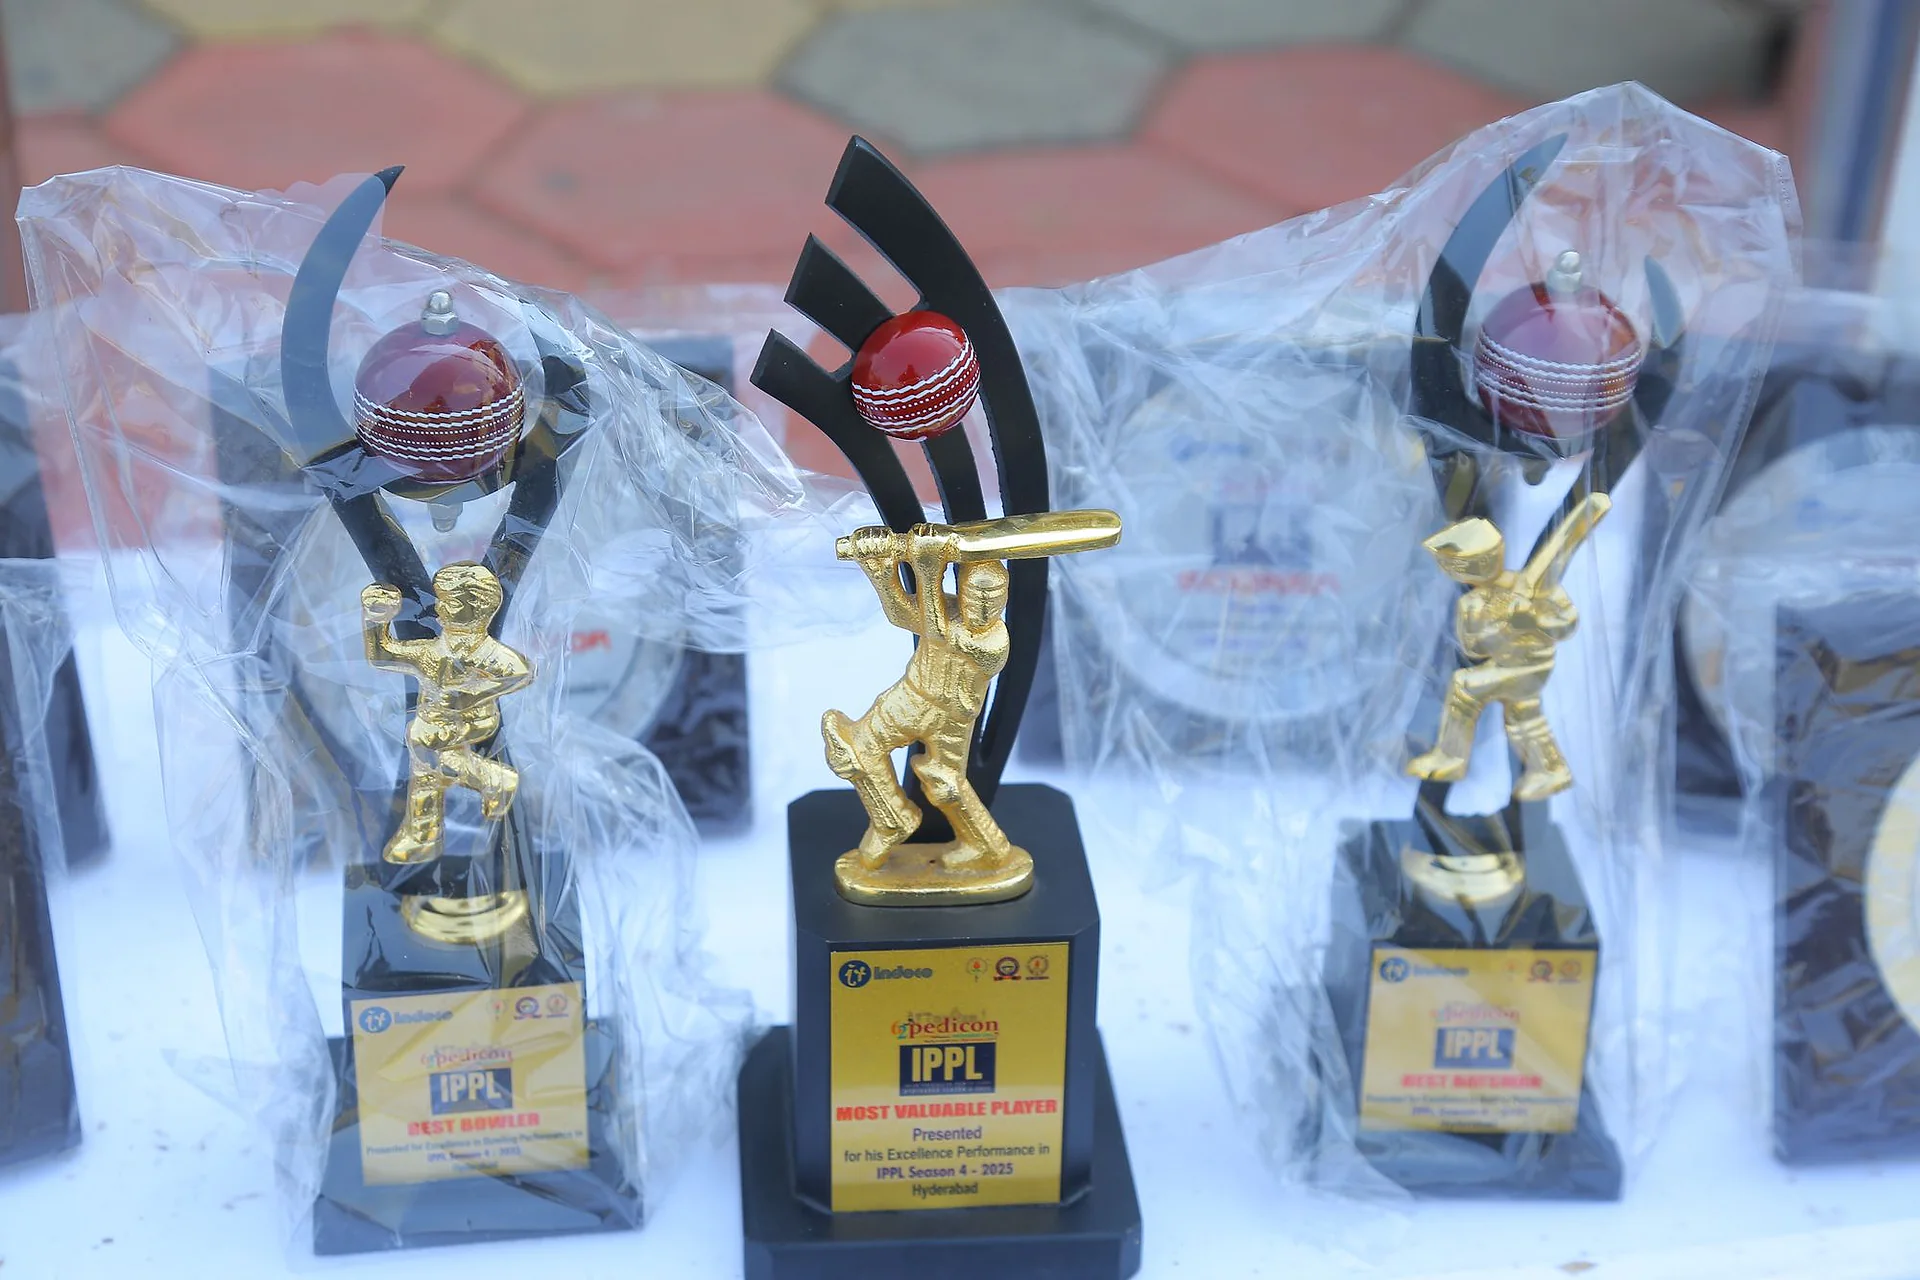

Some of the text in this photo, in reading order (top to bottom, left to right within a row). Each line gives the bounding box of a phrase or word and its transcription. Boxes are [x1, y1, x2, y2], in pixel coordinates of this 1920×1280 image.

[874, 965, 934, 980] Indoco
[1445, 1029, 1504, 1059] IPPL
[912, 1046, 983, 1082] IPPL
[441, 1071, 500, 1102] IPPL
[837, 1099, 1058, 1121] MOST VALUABLE PLAYER
[407, 1112, 540, 1136] BEST BOWLER
[913, 1126, 982, 1141] Presented
[844, 1142, 1050, 1162] for his Excellence Performance in
[877, 1167, 905, 1180] IPPL
[908, 1165, 955, 1179] Season
[959, 1164, 967, 1175] 4
[982, 1162, 1013, 1176] 2025
[912, 1182, 978, 1199] Hyderabad
